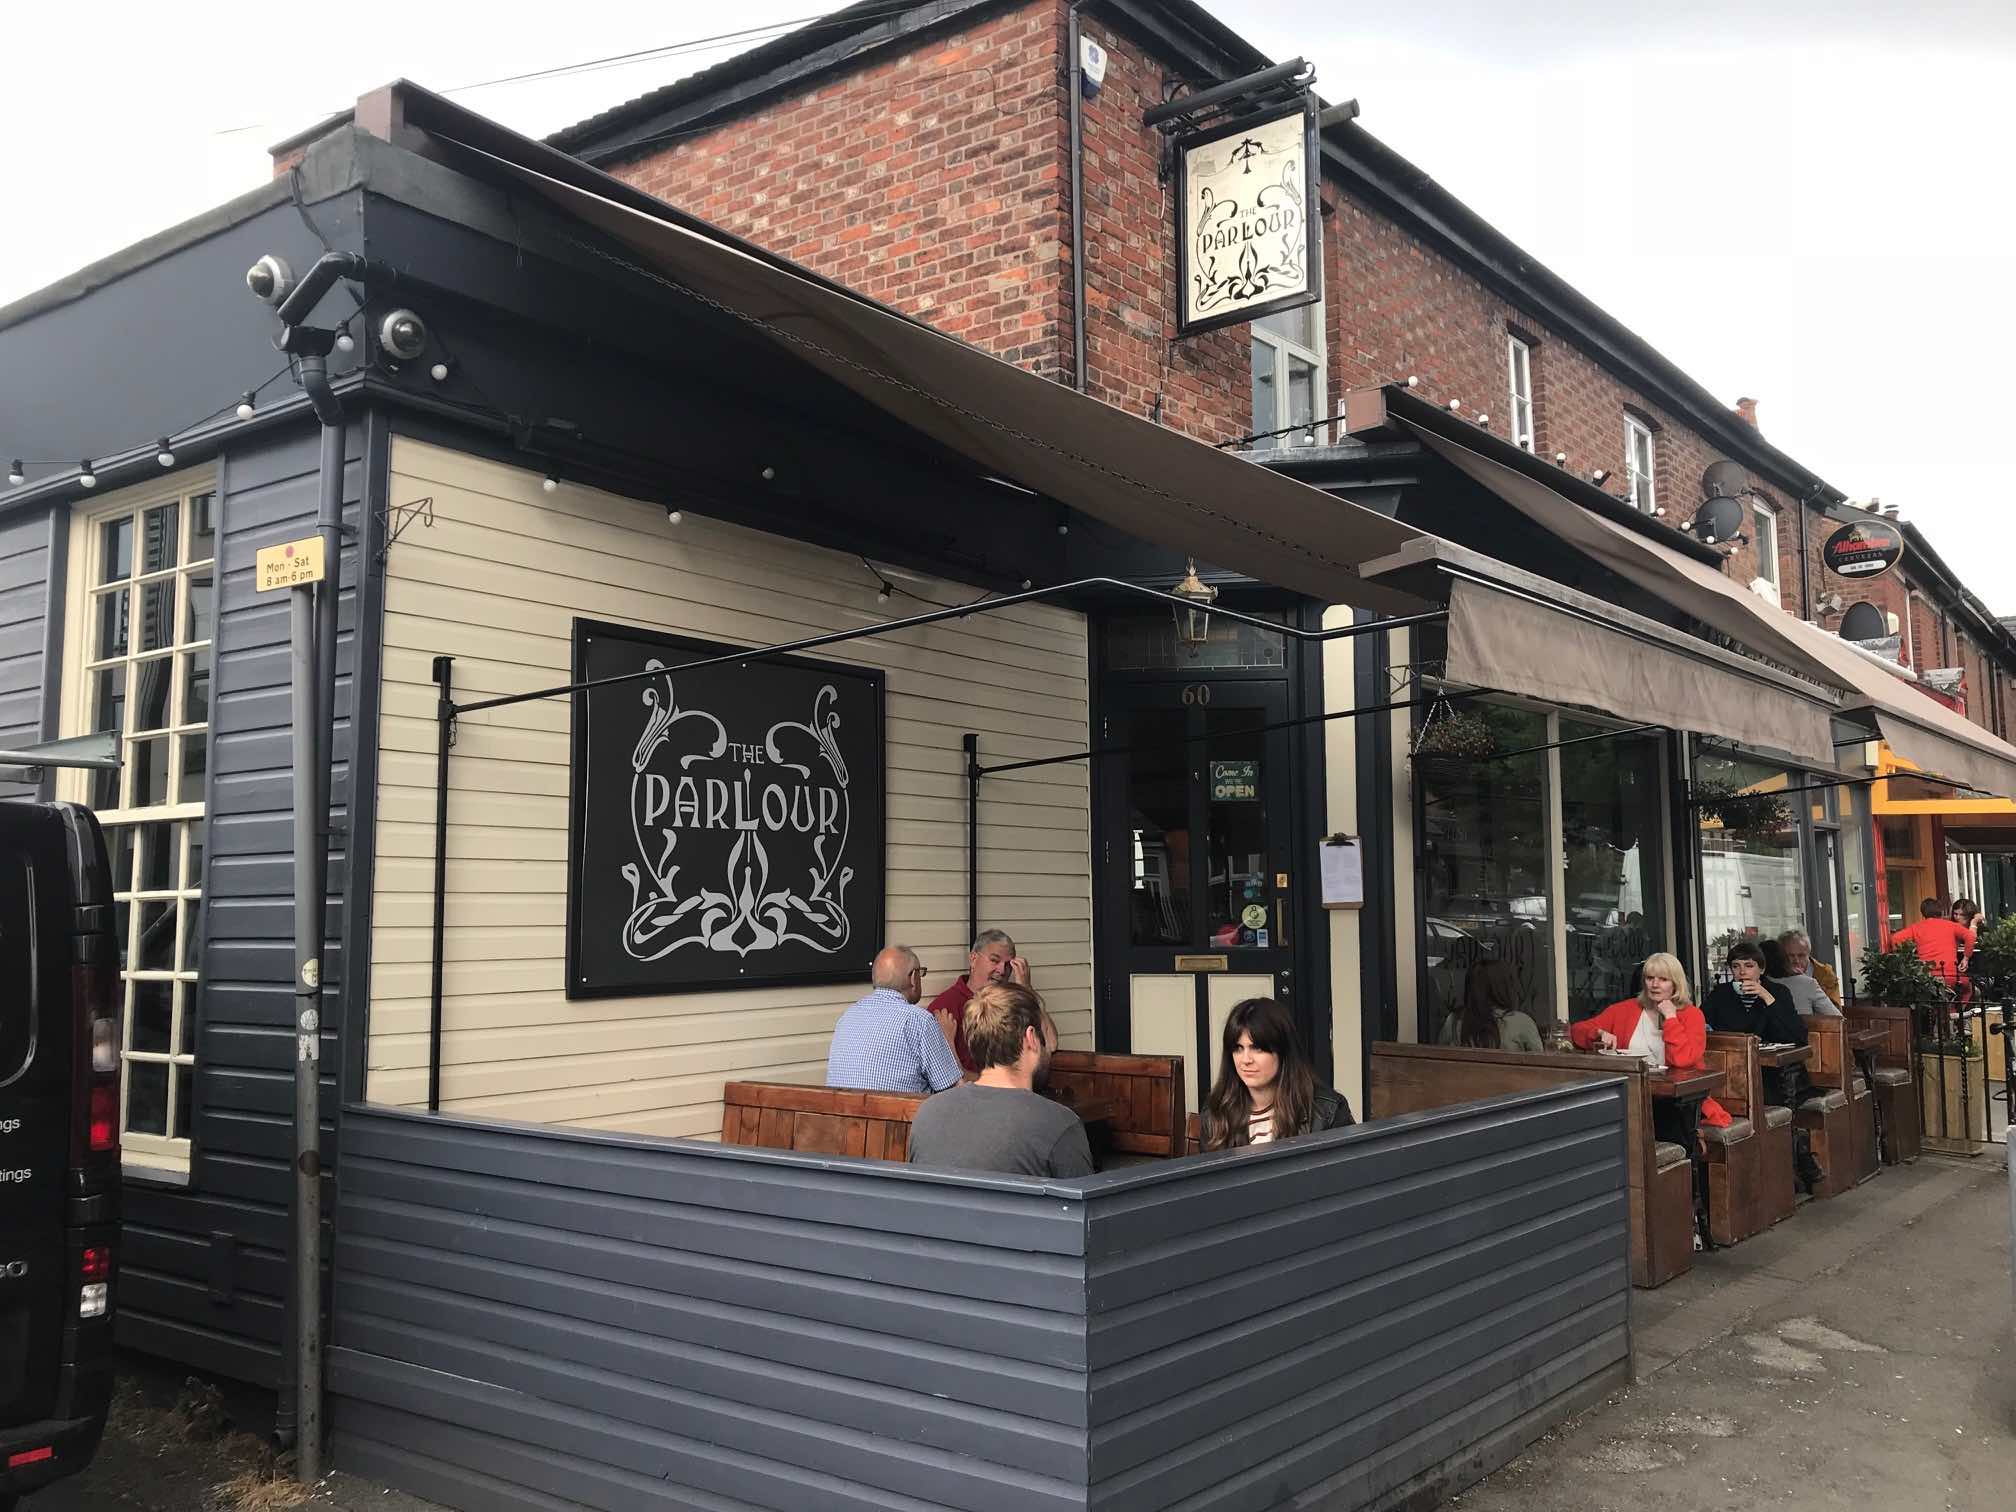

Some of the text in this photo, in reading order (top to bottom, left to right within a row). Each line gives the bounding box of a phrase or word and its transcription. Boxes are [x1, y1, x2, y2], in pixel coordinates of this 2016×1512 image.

[1240, 207, 1256, 218] THE
[1203, 209, 1294, 253] PARLOUR
[1832, 538, 1889, 554] Alham
[266, 562, 285, 573] Mon
[294, 556, 310, 568] Sat
[266, 577, 272, 586] 8
[300, 570, 313, 579] pm
[1182, 684, 1210, 705] 60
[728, 742, 765, 764] THE
[1215, 764, 1254, 779] Come In
[1215, 784, 1255, 798] OPEN
[643, 770, 839, 834] PARLOUR
